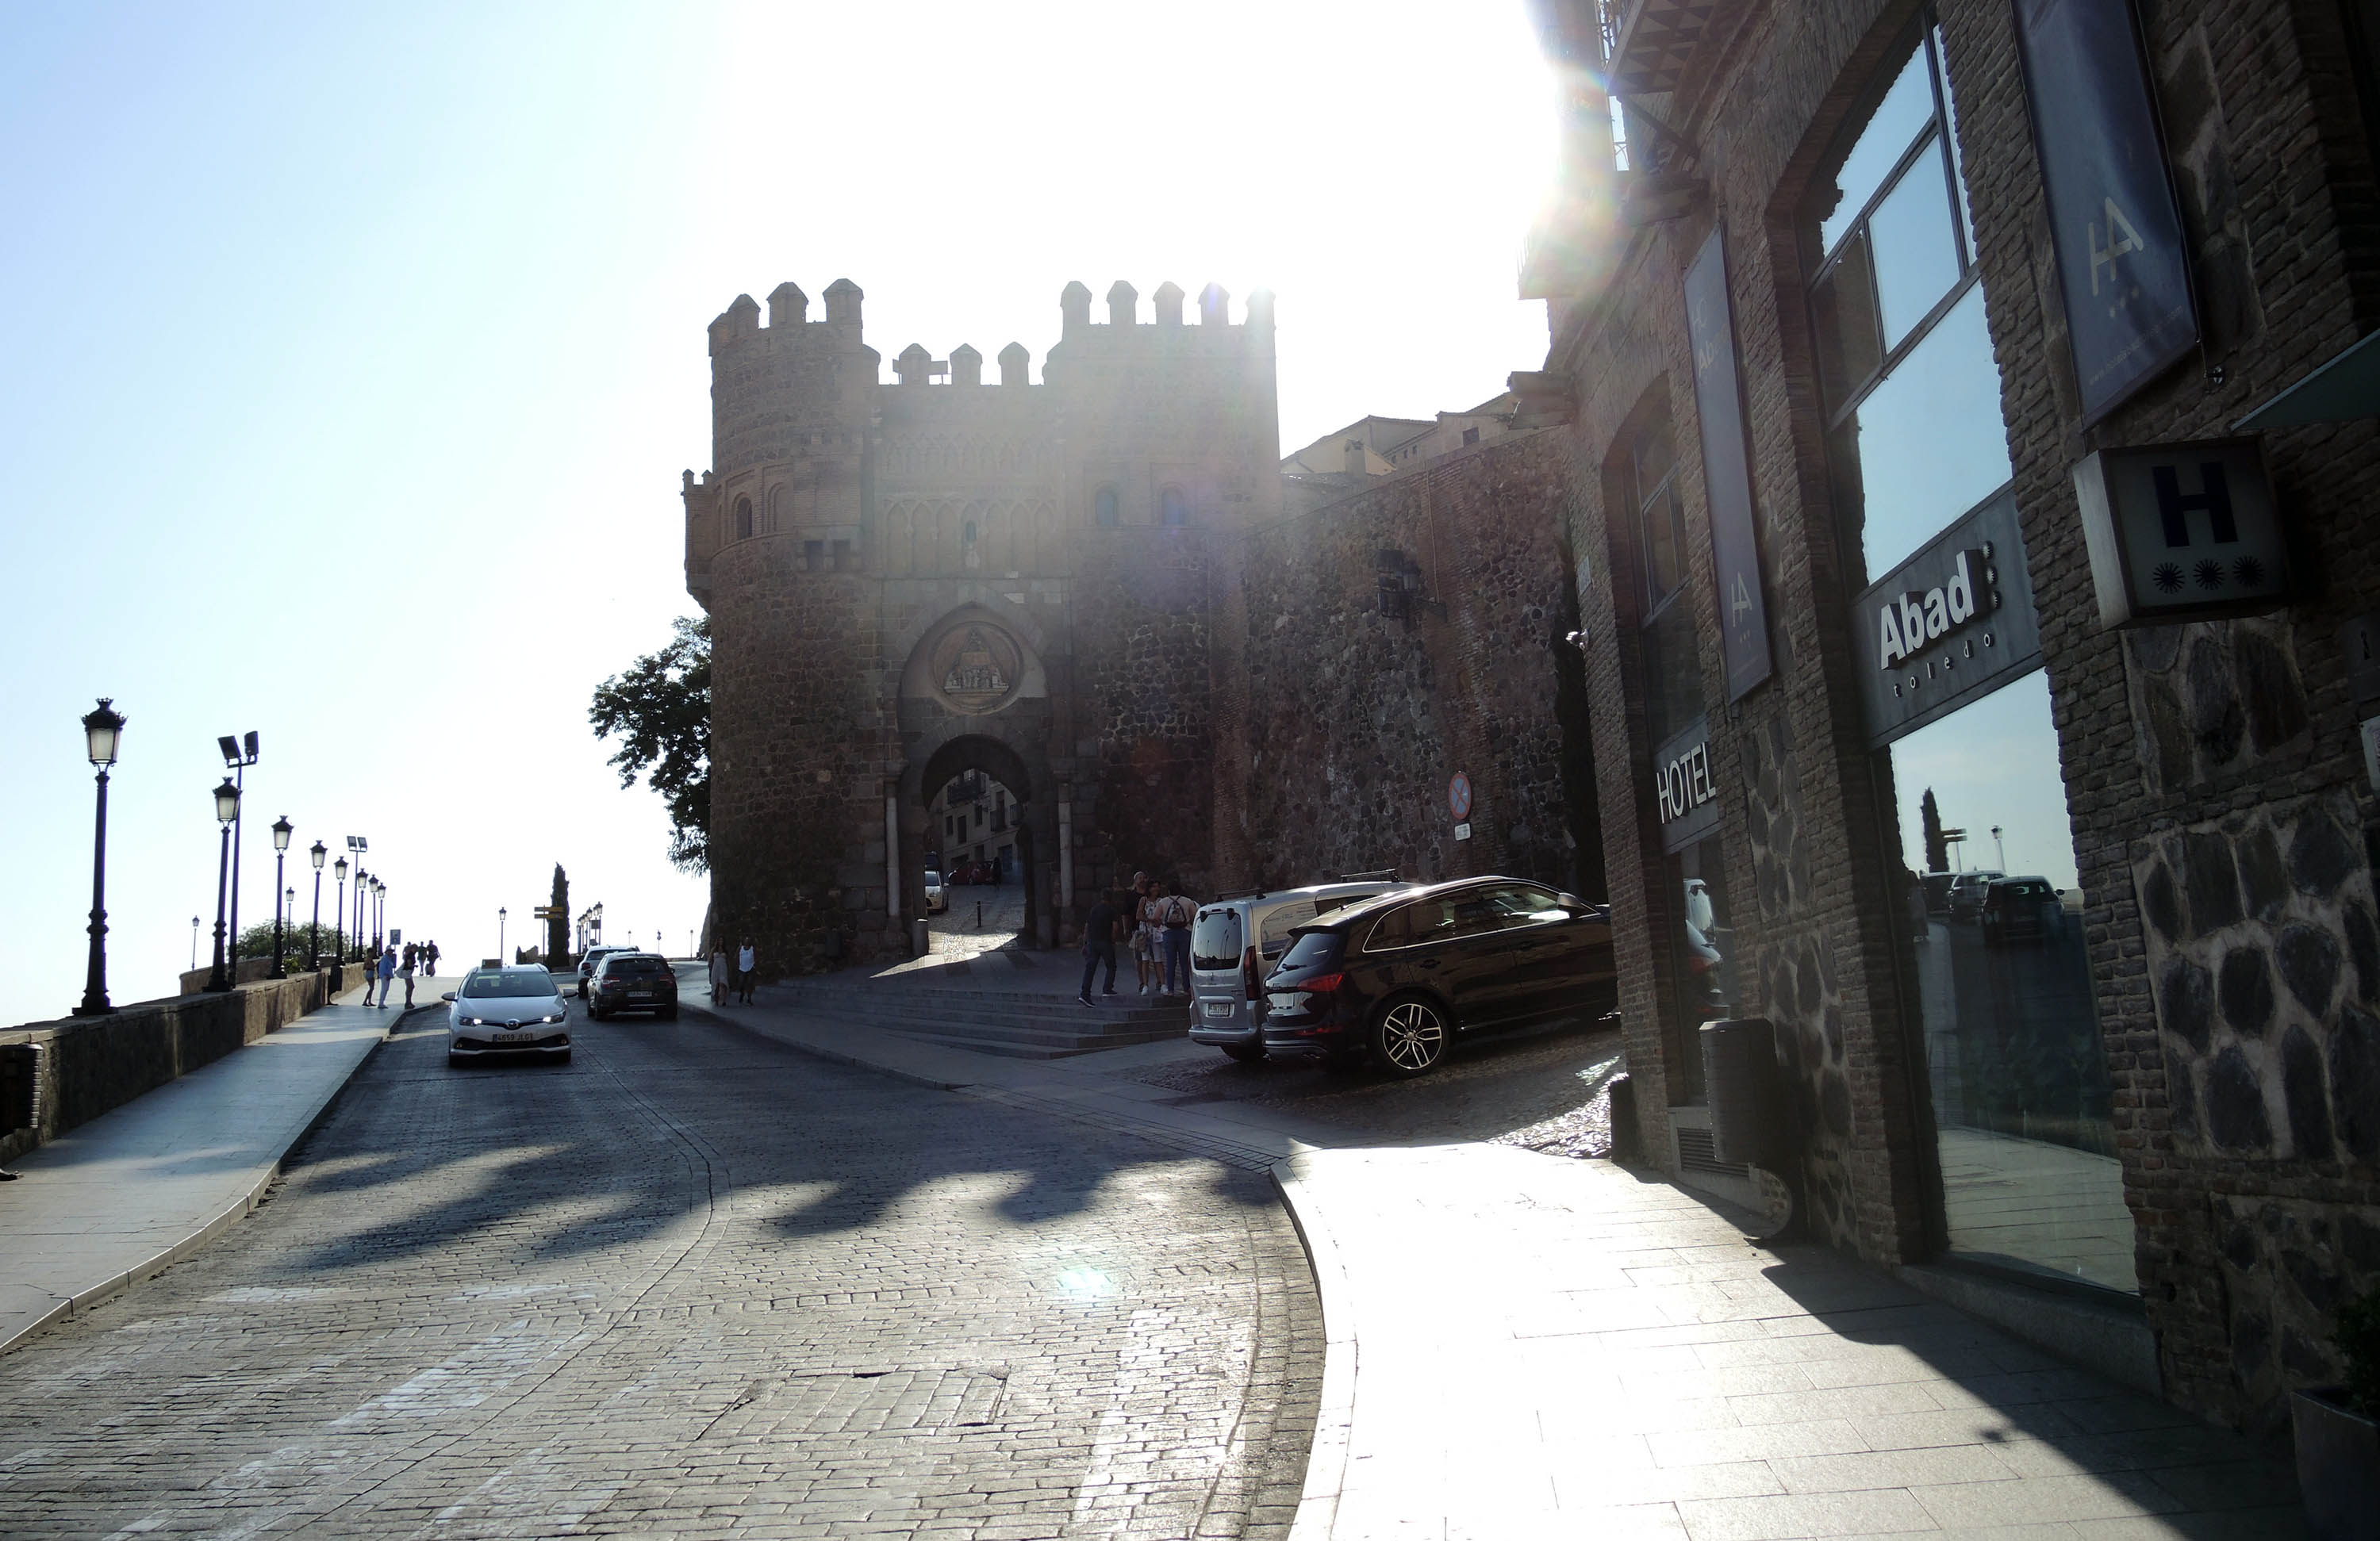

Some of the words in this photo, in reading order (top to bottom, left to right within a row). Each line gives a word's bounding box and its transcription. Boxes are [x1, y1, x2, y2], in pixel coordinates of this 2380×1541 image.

[2152, 461, 2239, 548] H
[1880, 550, 1975, 671] Abad
[1894, 633, 1992, 698] toledo
[1656, 742, 1717, 824] HOTEL
